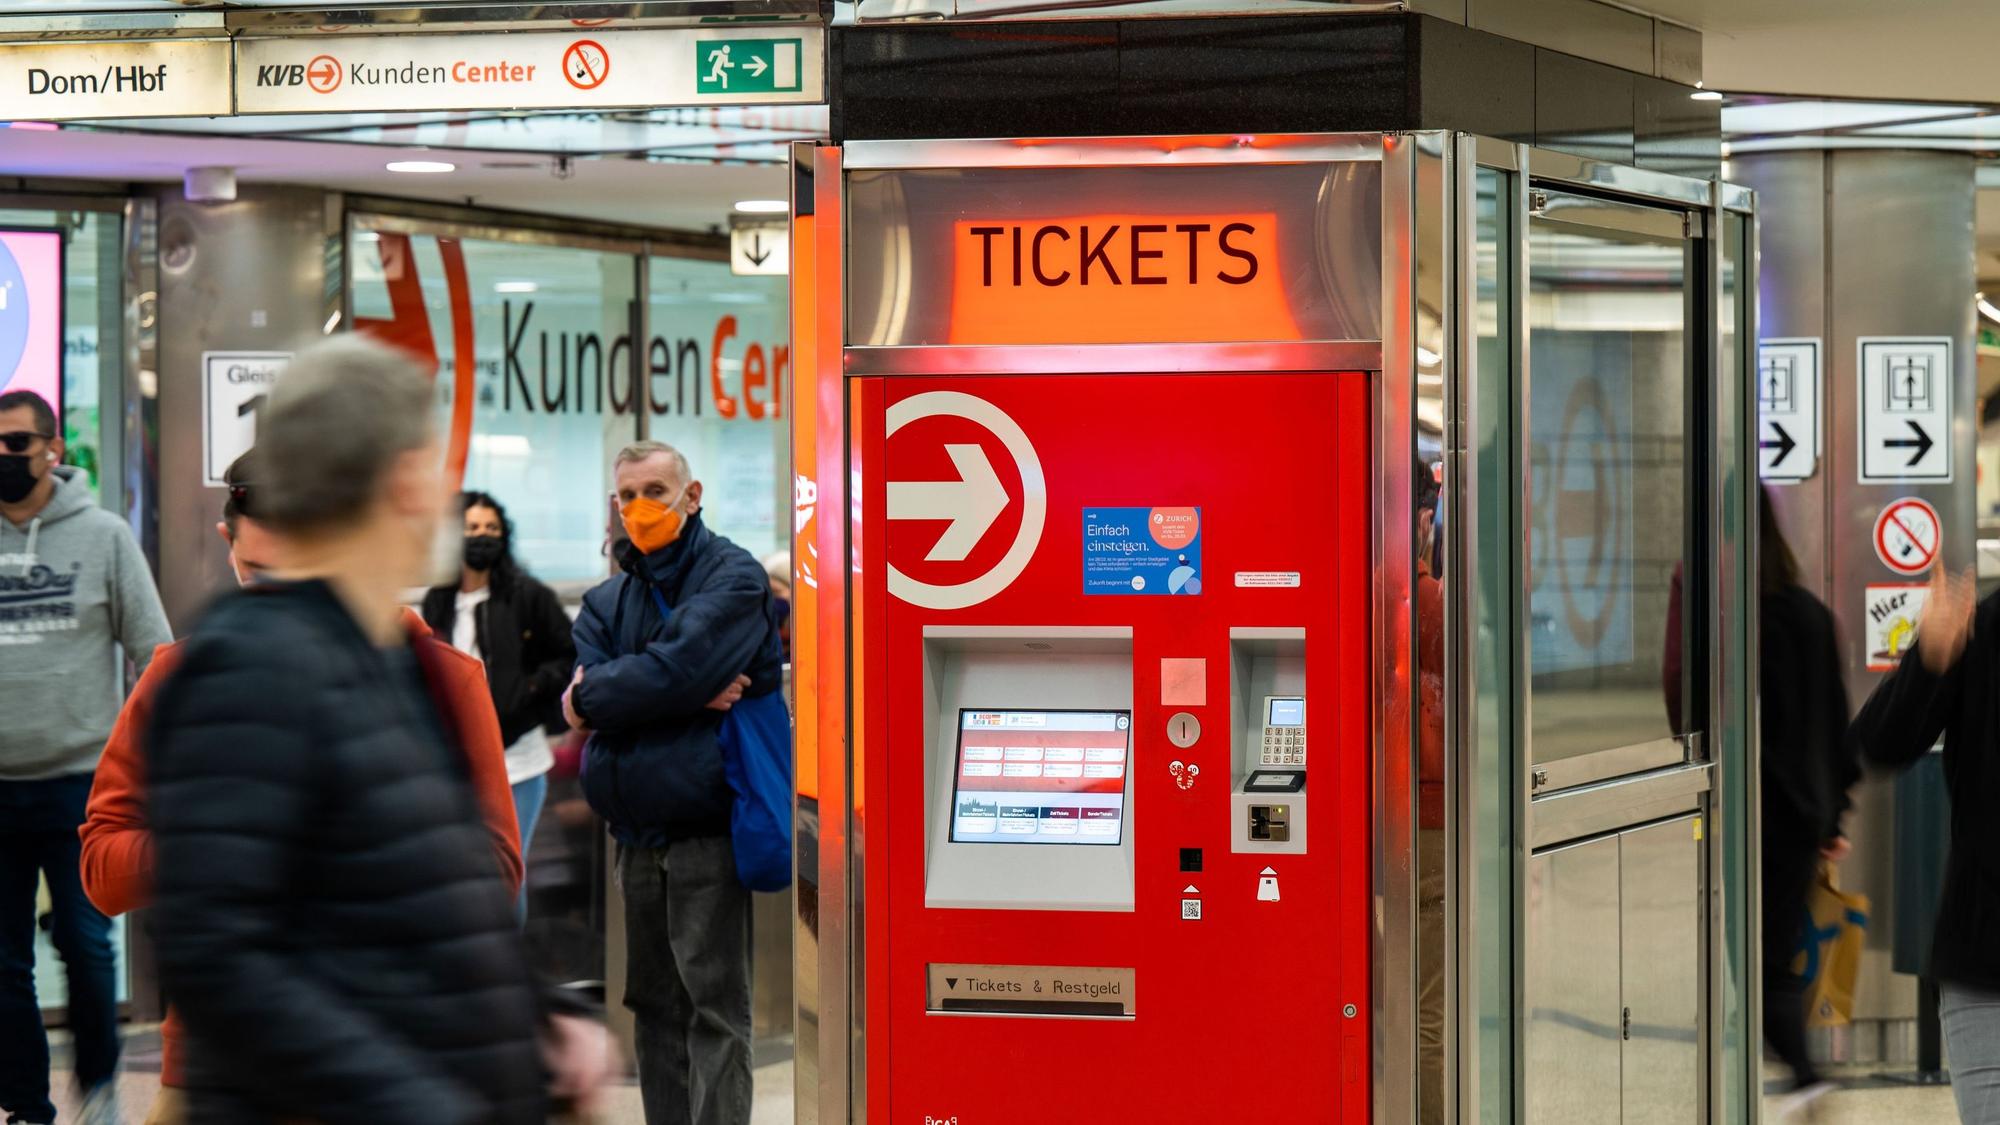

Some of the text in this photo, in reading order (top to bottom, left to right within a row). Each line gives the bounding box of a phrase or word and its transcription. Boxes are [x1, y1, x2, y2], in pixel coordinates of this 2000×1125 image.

[28, 65, 167, 94] Dom/Hbf
[257, 61, 536, 87] KVB Kunden Center
[970, 223, 1259, 287] TICKETS
[503, 300, 702, 416] Kunden
[1087, 524, 1130, 536] Einfach
[1087, 540, 1150, 555] einsteigen.
[1869, 591, 1909, 624] Hier
[966, 978, 1121, 997] Tickets & Restgeld
